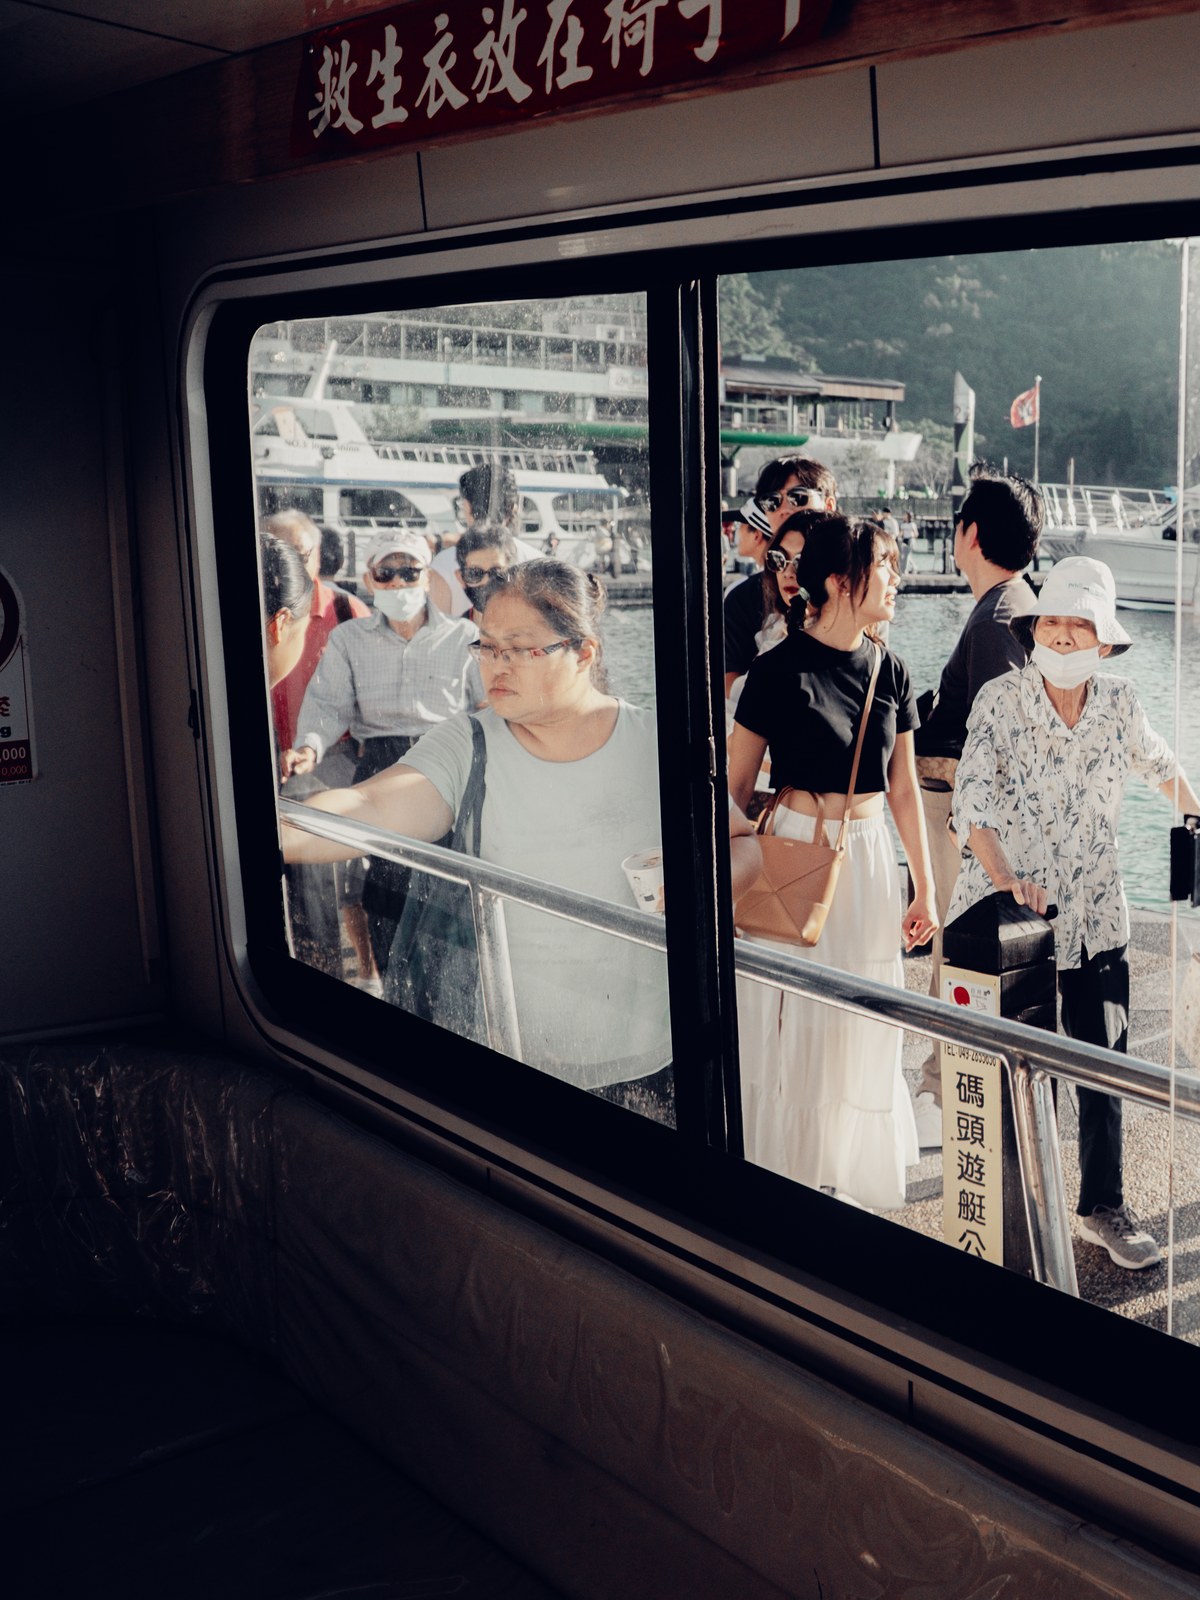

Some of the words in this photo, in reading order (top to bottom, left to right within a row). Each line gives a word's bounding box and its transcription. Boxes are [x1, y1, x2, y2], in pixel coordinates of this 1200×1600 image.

[956, 1071, 986, 1257] 碼頭遊艇公
